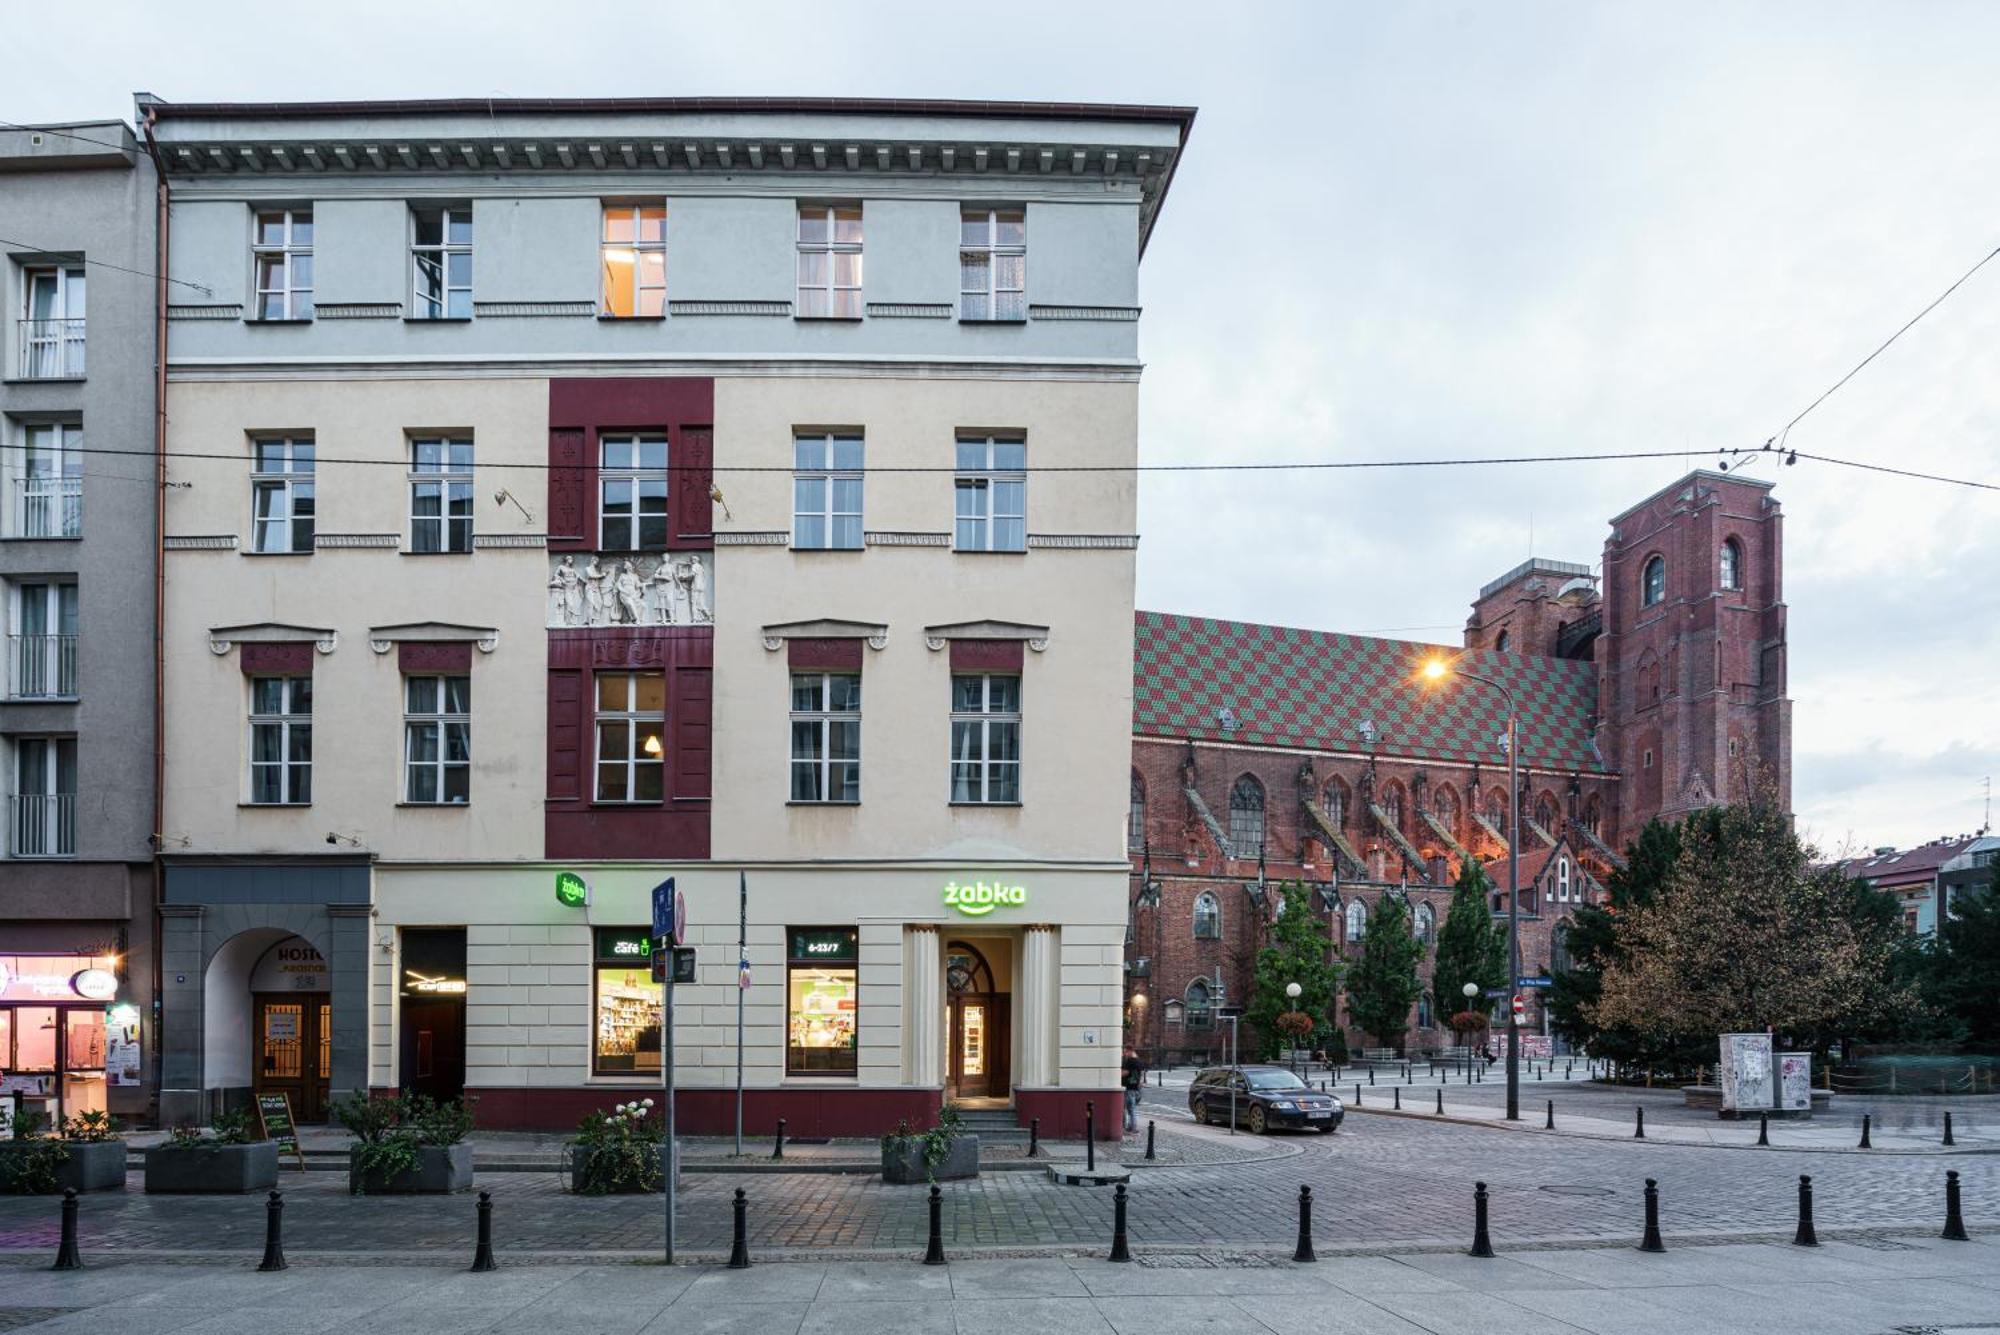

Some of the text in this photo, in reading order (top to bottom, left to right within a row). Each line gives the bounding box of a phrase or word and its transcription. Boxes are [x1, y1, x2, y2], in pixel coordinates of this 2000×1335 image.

[562, 878, 584, 898] żabka
[944, 882, 1025, 903] żabka
[614, 943, 640, 954] café
[808, 943, 839, 952] 6-23/7
